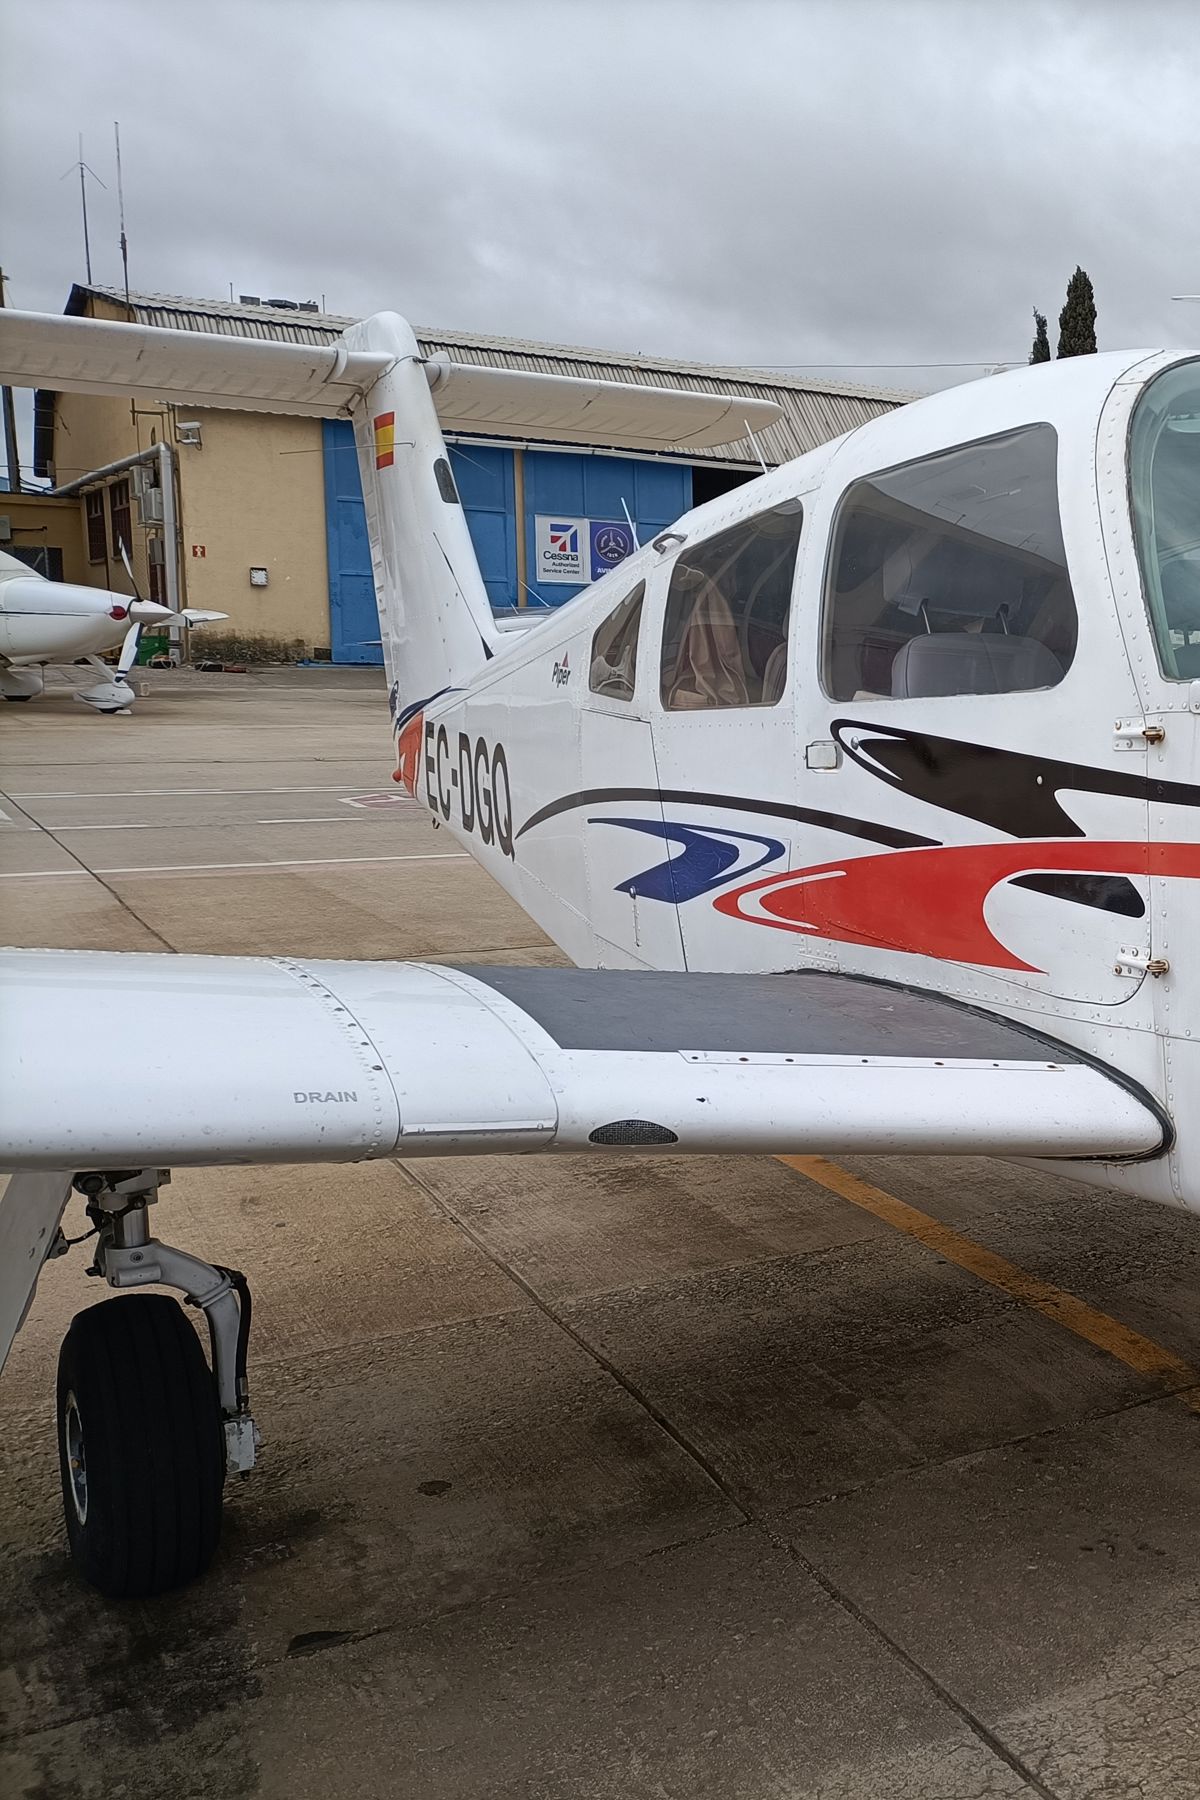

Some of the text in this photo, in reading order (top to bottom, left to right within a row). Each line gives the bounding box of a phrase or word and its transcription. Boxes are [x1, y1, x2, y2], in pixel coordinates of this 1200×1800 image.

[543, 551, 579, 561] Cessna
[551, 662, 571, 688] Piper
[425, 721, 515, 862] EC-DGQ
[293, 1091, 358, 1104] DRAIN
